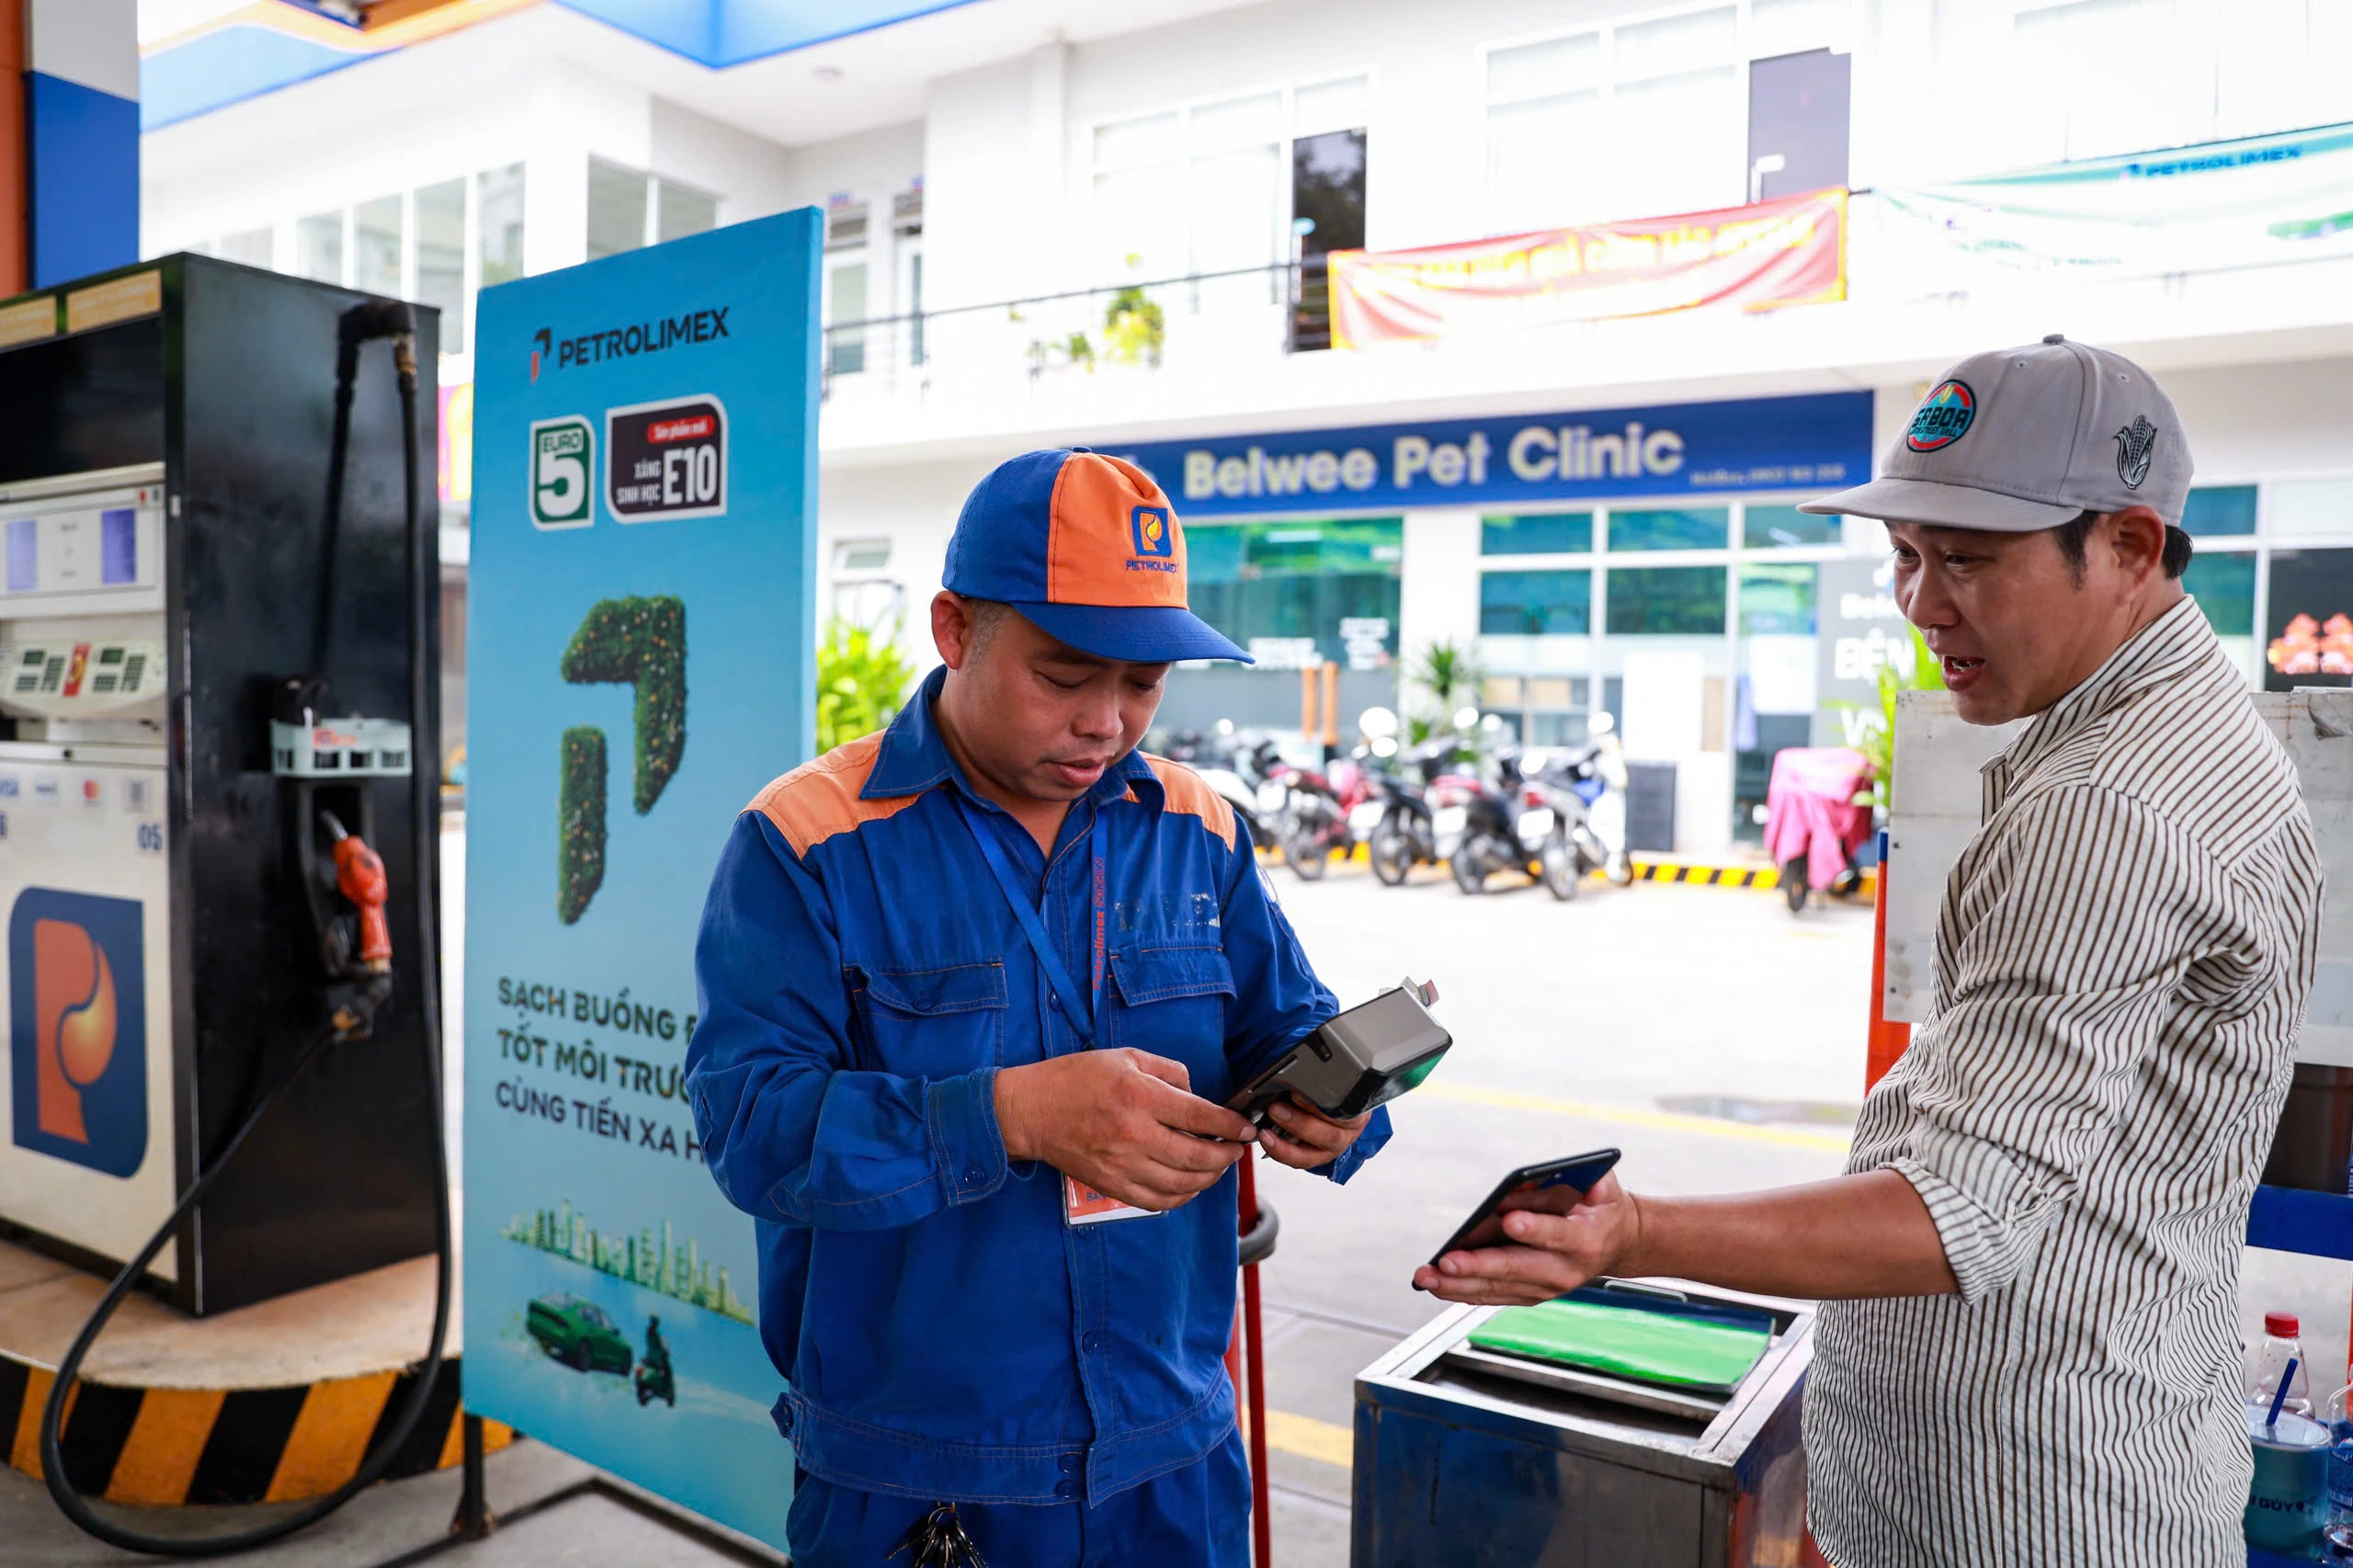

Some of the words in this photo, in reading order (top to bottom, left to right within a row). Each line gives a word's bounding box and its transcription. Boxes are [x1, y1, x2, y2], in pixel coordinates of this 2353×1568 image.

[559, 306, 729, 369] PETROLIMEX
[541, 430, 582, 451] EURO
[1184, 446, 1377, 499] Belwee
[1393, 432, 1491, 489] Pet
[1507, 422, 1686, 482] Clinic
[538, 449, 585, 517] 5
[664, 444, 718, 505] E10
[139, 823, 163, 851] 05
[498, 977, 566, 1017] SẠCH
[555, 1039, 608, 1084] MÔI
[639, 1118, 678, 1157] XA
